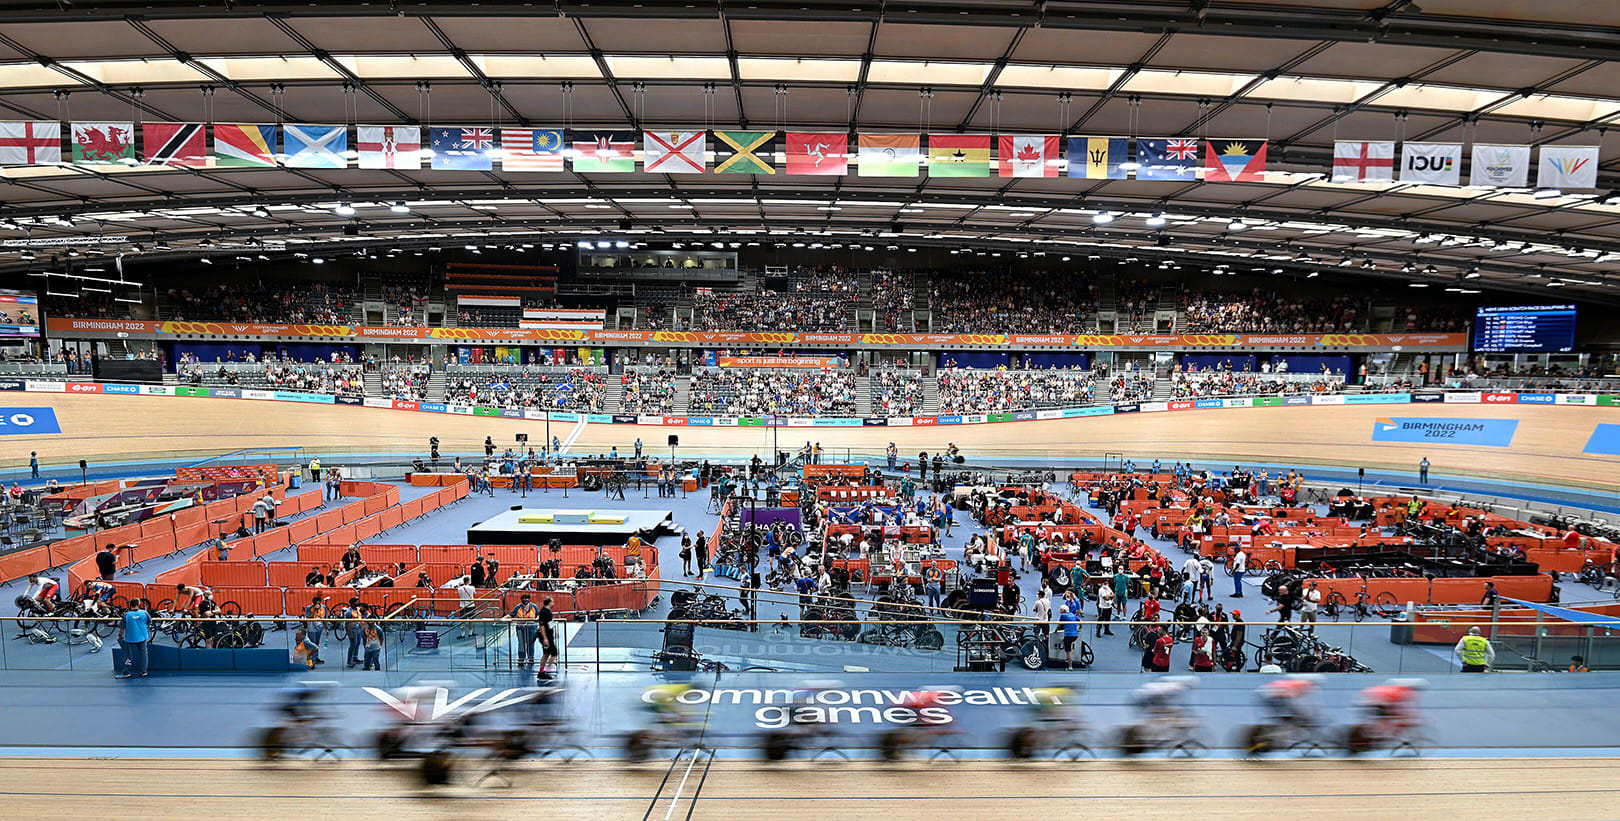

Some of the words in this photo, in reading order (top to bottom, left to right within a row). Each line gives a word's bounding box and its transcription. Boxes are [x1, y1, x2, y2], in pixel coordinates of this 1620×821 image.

[73, 321, 124, 330] BIRMINGHAM
[125, 322, 145, 330] 2022
[363, 328, 402, 336] BIRMINGHAM
[1248, 336, 1289, 344] BIRMINGHAM
[1289, 336, 1306, 344] 2022
[1402, 422, 1484, 432] BIRMINGHAM
[1424, 430, 1456, 438] 2022
[641, 687, 1062, 705] commonwealth
[754, 706, 953, 728] games
